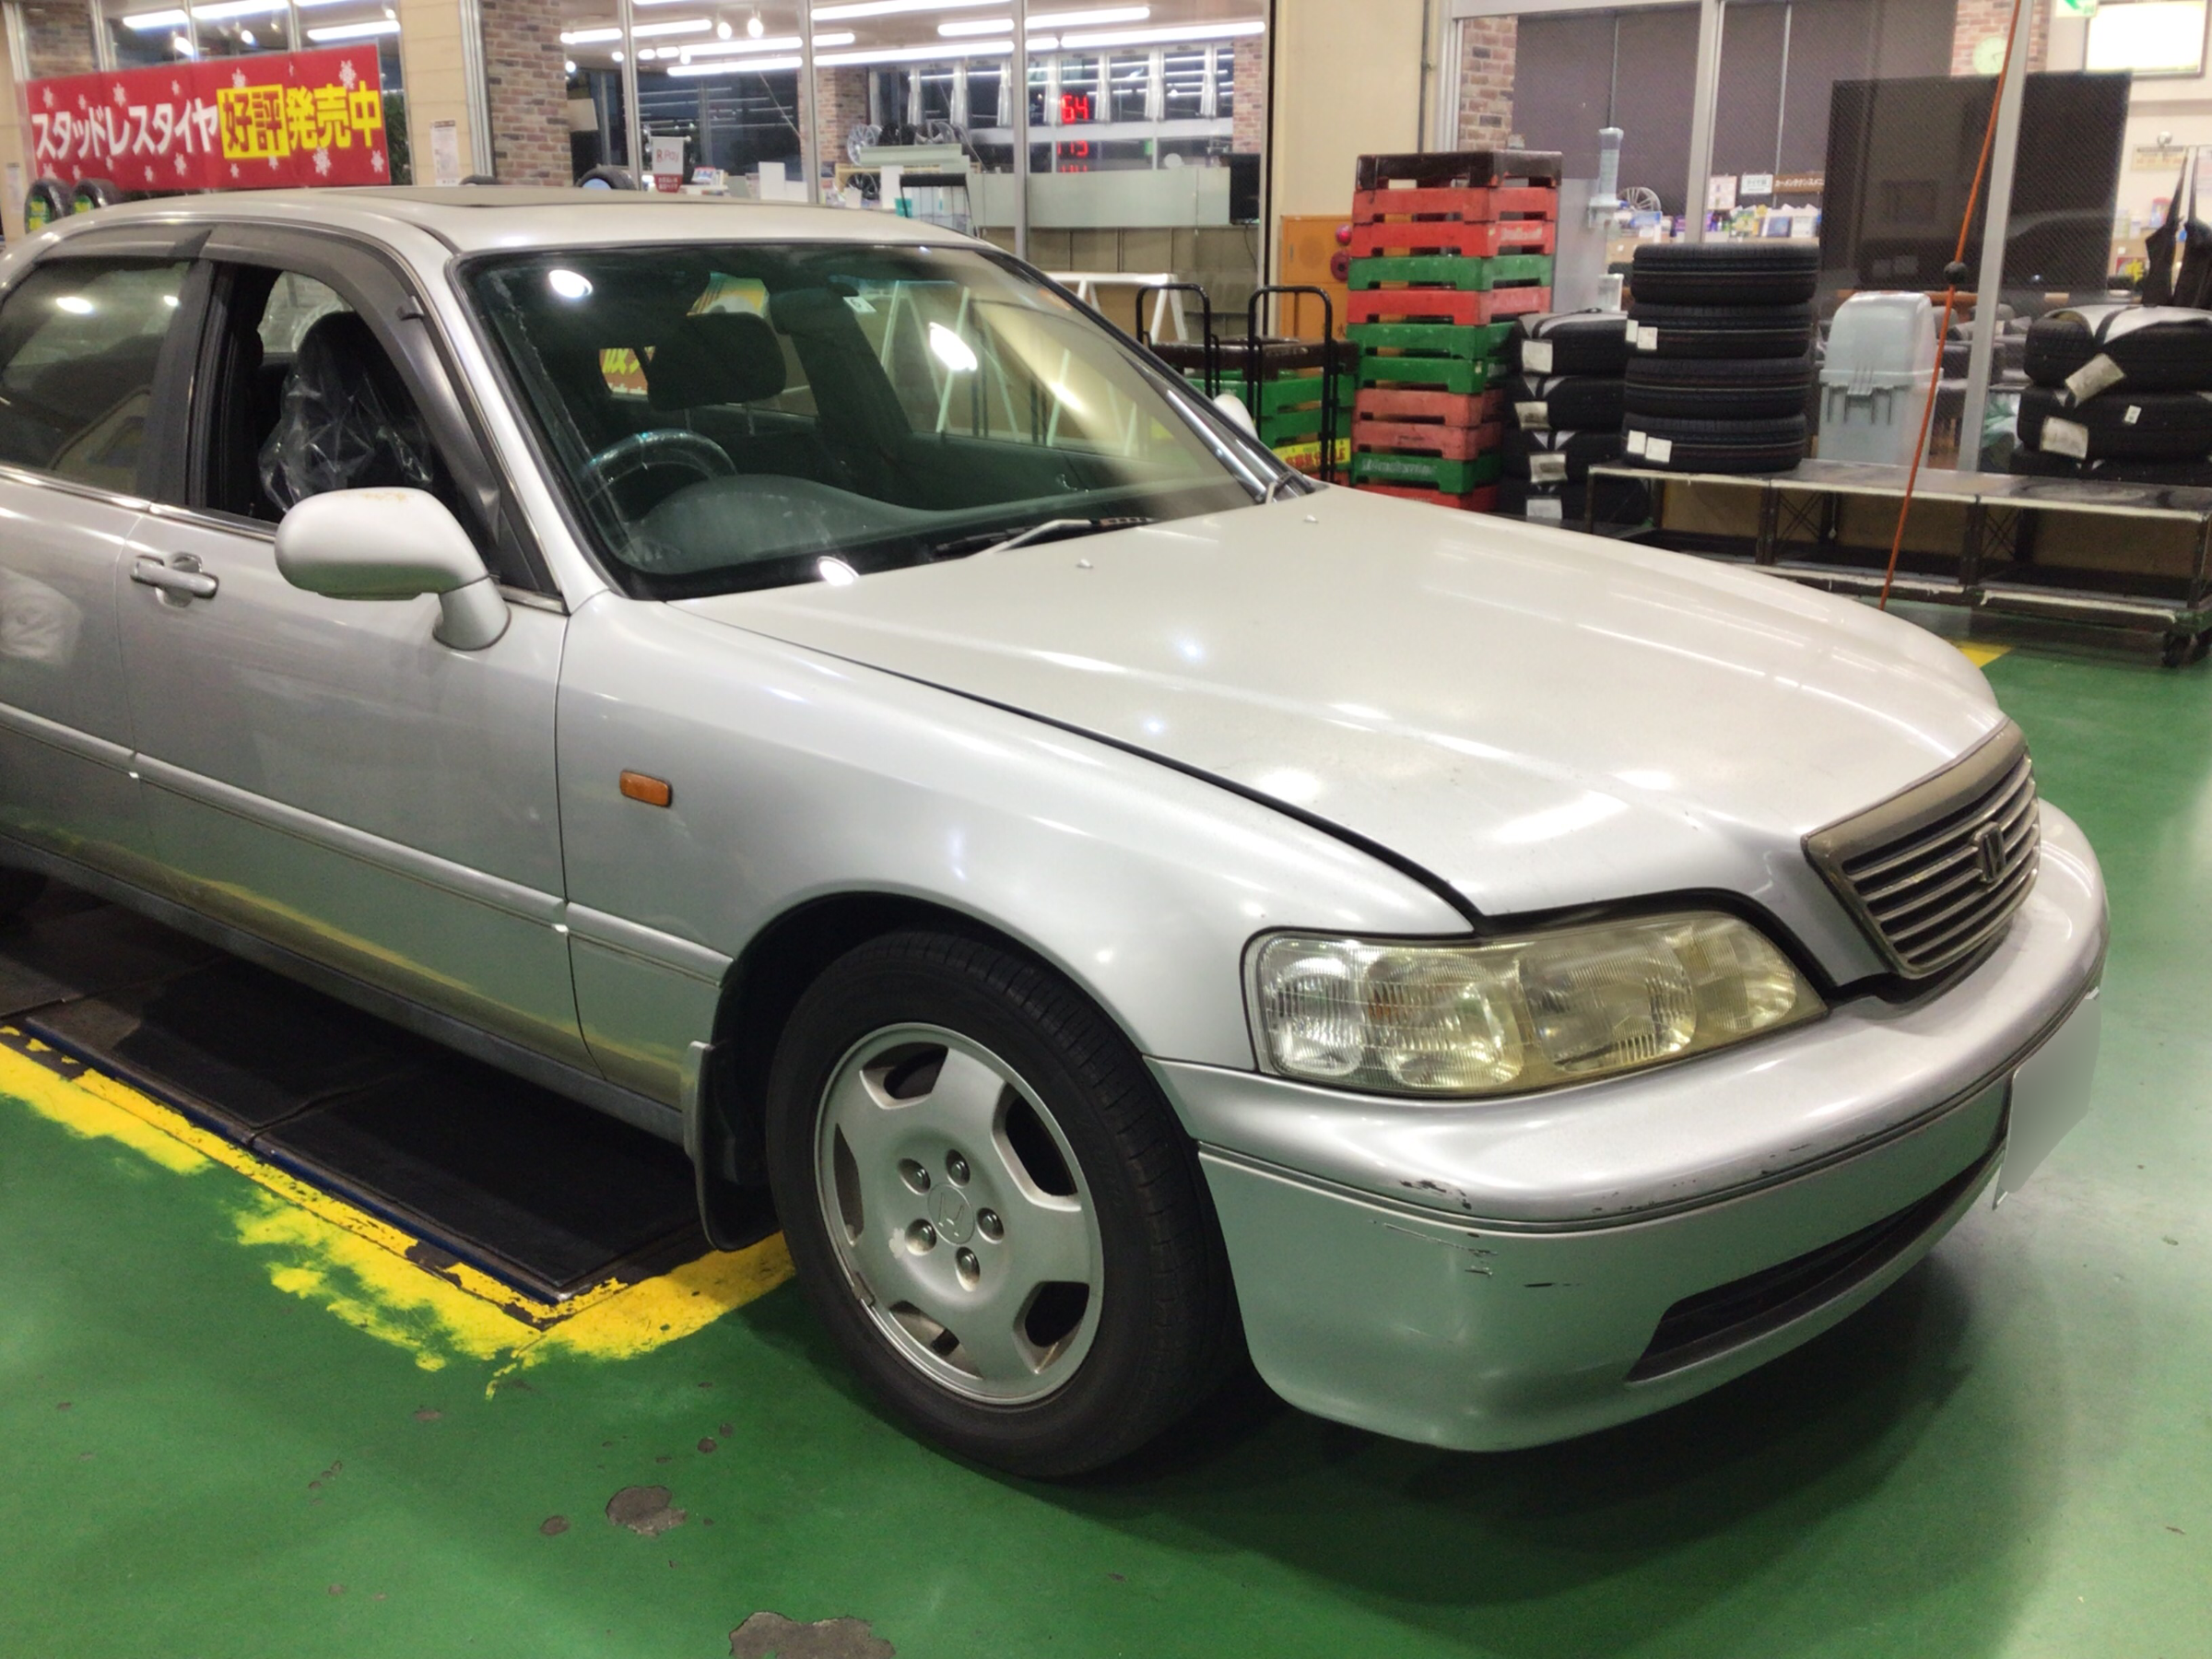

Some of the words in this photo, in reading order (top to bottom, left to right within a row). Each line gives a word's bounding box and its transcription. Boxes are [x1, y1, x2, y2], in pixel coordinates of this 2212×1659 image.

[31, 97, 218, 160] スタッドレスタイヤ
[217, 79, 383, 159] 好評発売中
